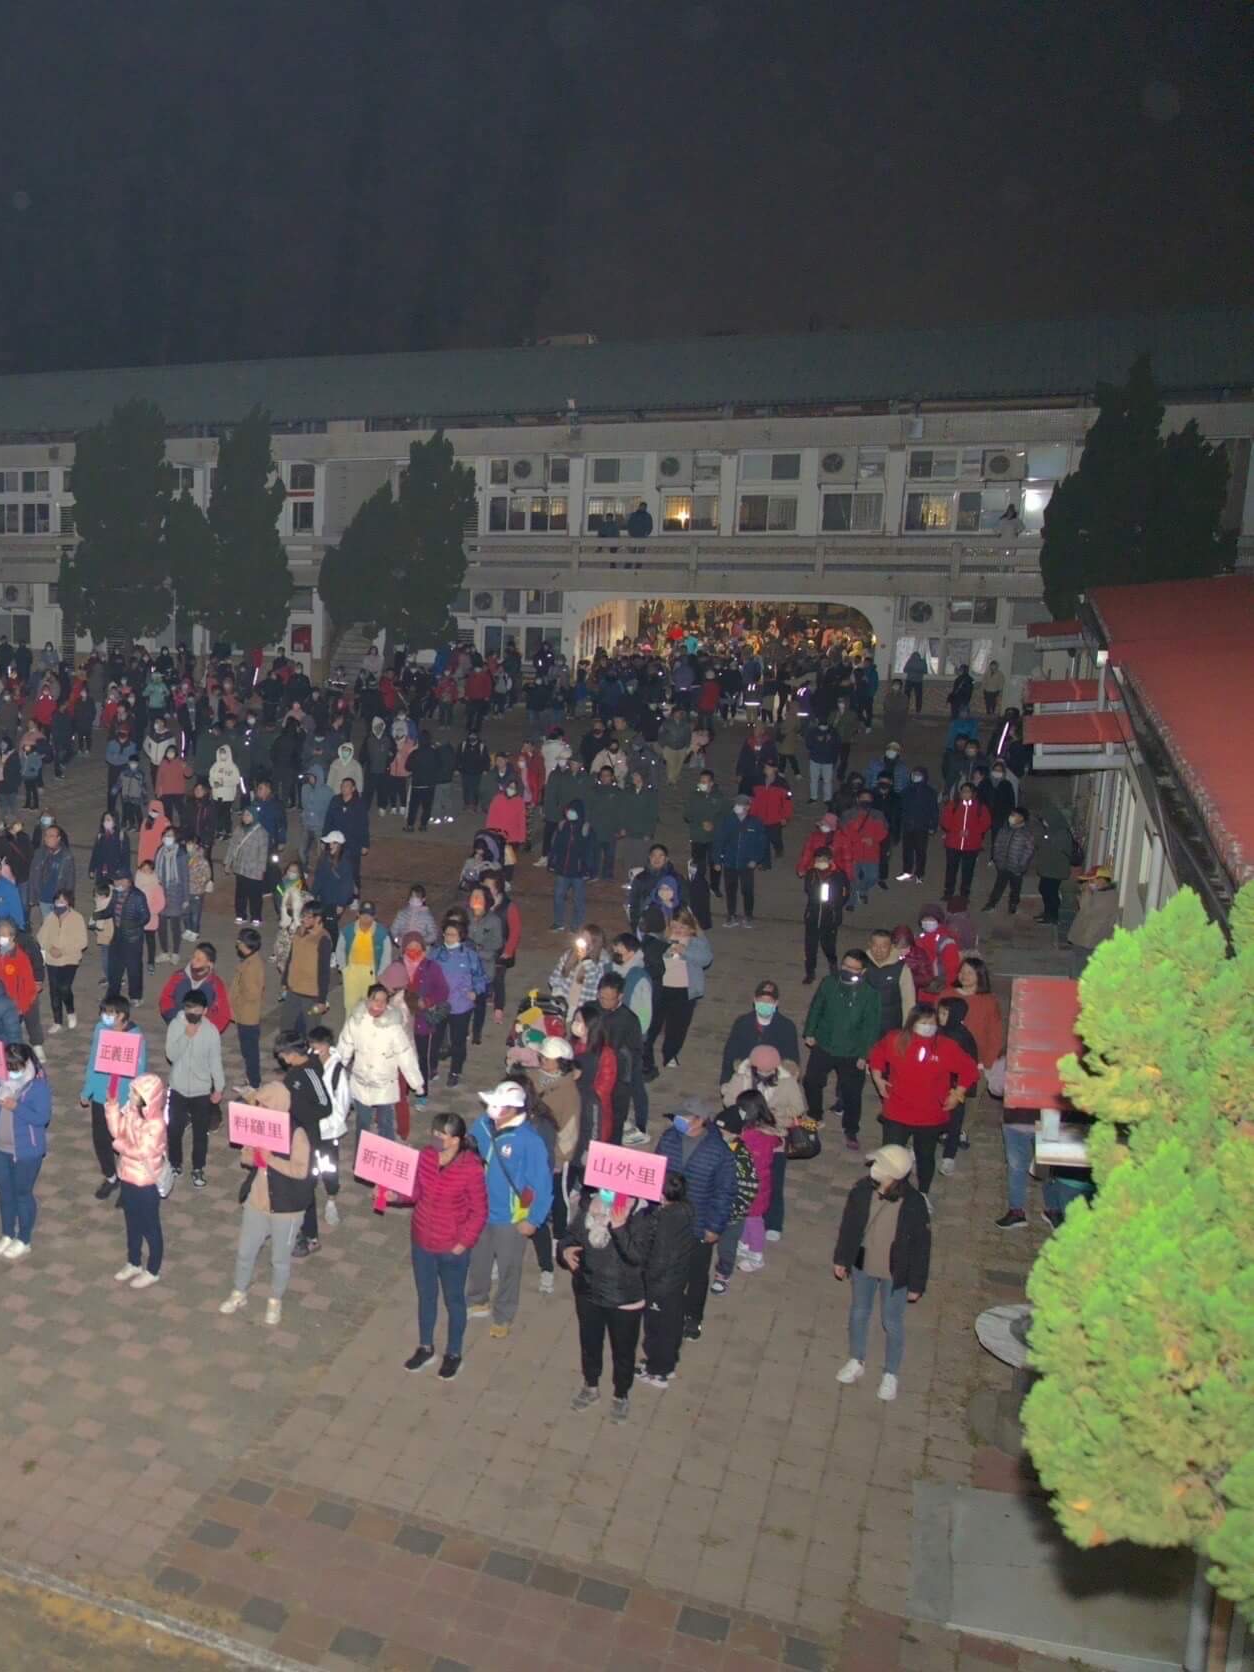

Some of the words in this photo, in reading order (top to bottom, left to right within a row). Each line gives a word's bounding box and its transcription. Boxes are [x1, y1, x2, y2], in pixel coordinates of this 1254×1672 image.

[99, 1044, 134, 1064] 正義里
[234, 1115, 282, 1140] 料羅里
[362, 1148, 410, 1181] 新市里
[593, 1158, 656, 1187] 山外里
